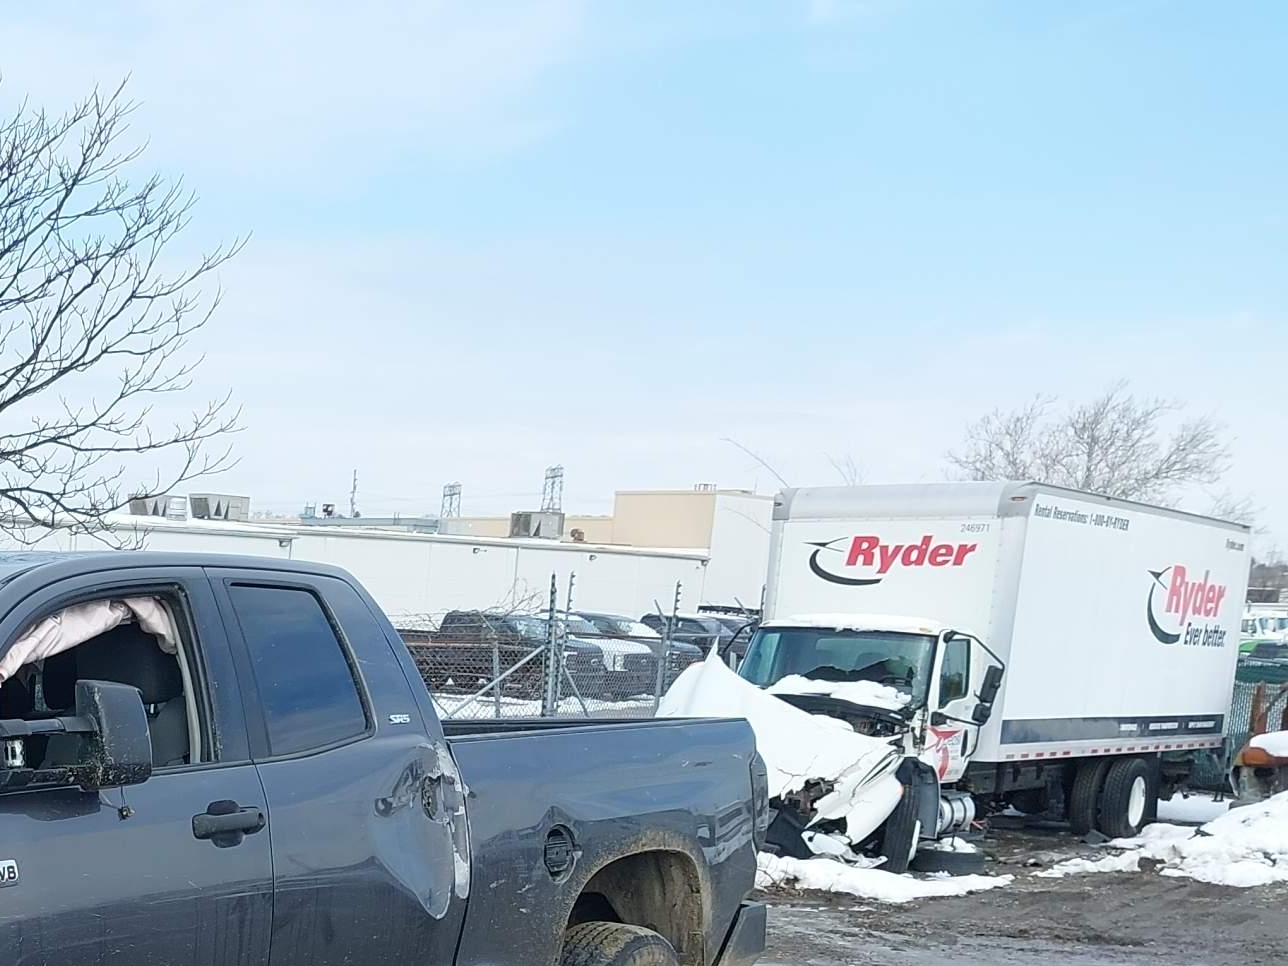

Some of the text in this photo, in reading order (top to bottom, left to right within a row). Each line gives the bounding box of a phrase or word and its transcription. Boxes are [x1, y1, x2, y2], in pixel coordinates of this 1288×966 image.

[845, 535, 978, 575] Ryder
[1165, 564, 1227, 627] Ryder
[1183, 621, 1203, 647] Ever
[389, 713, 411, 725] SR5
